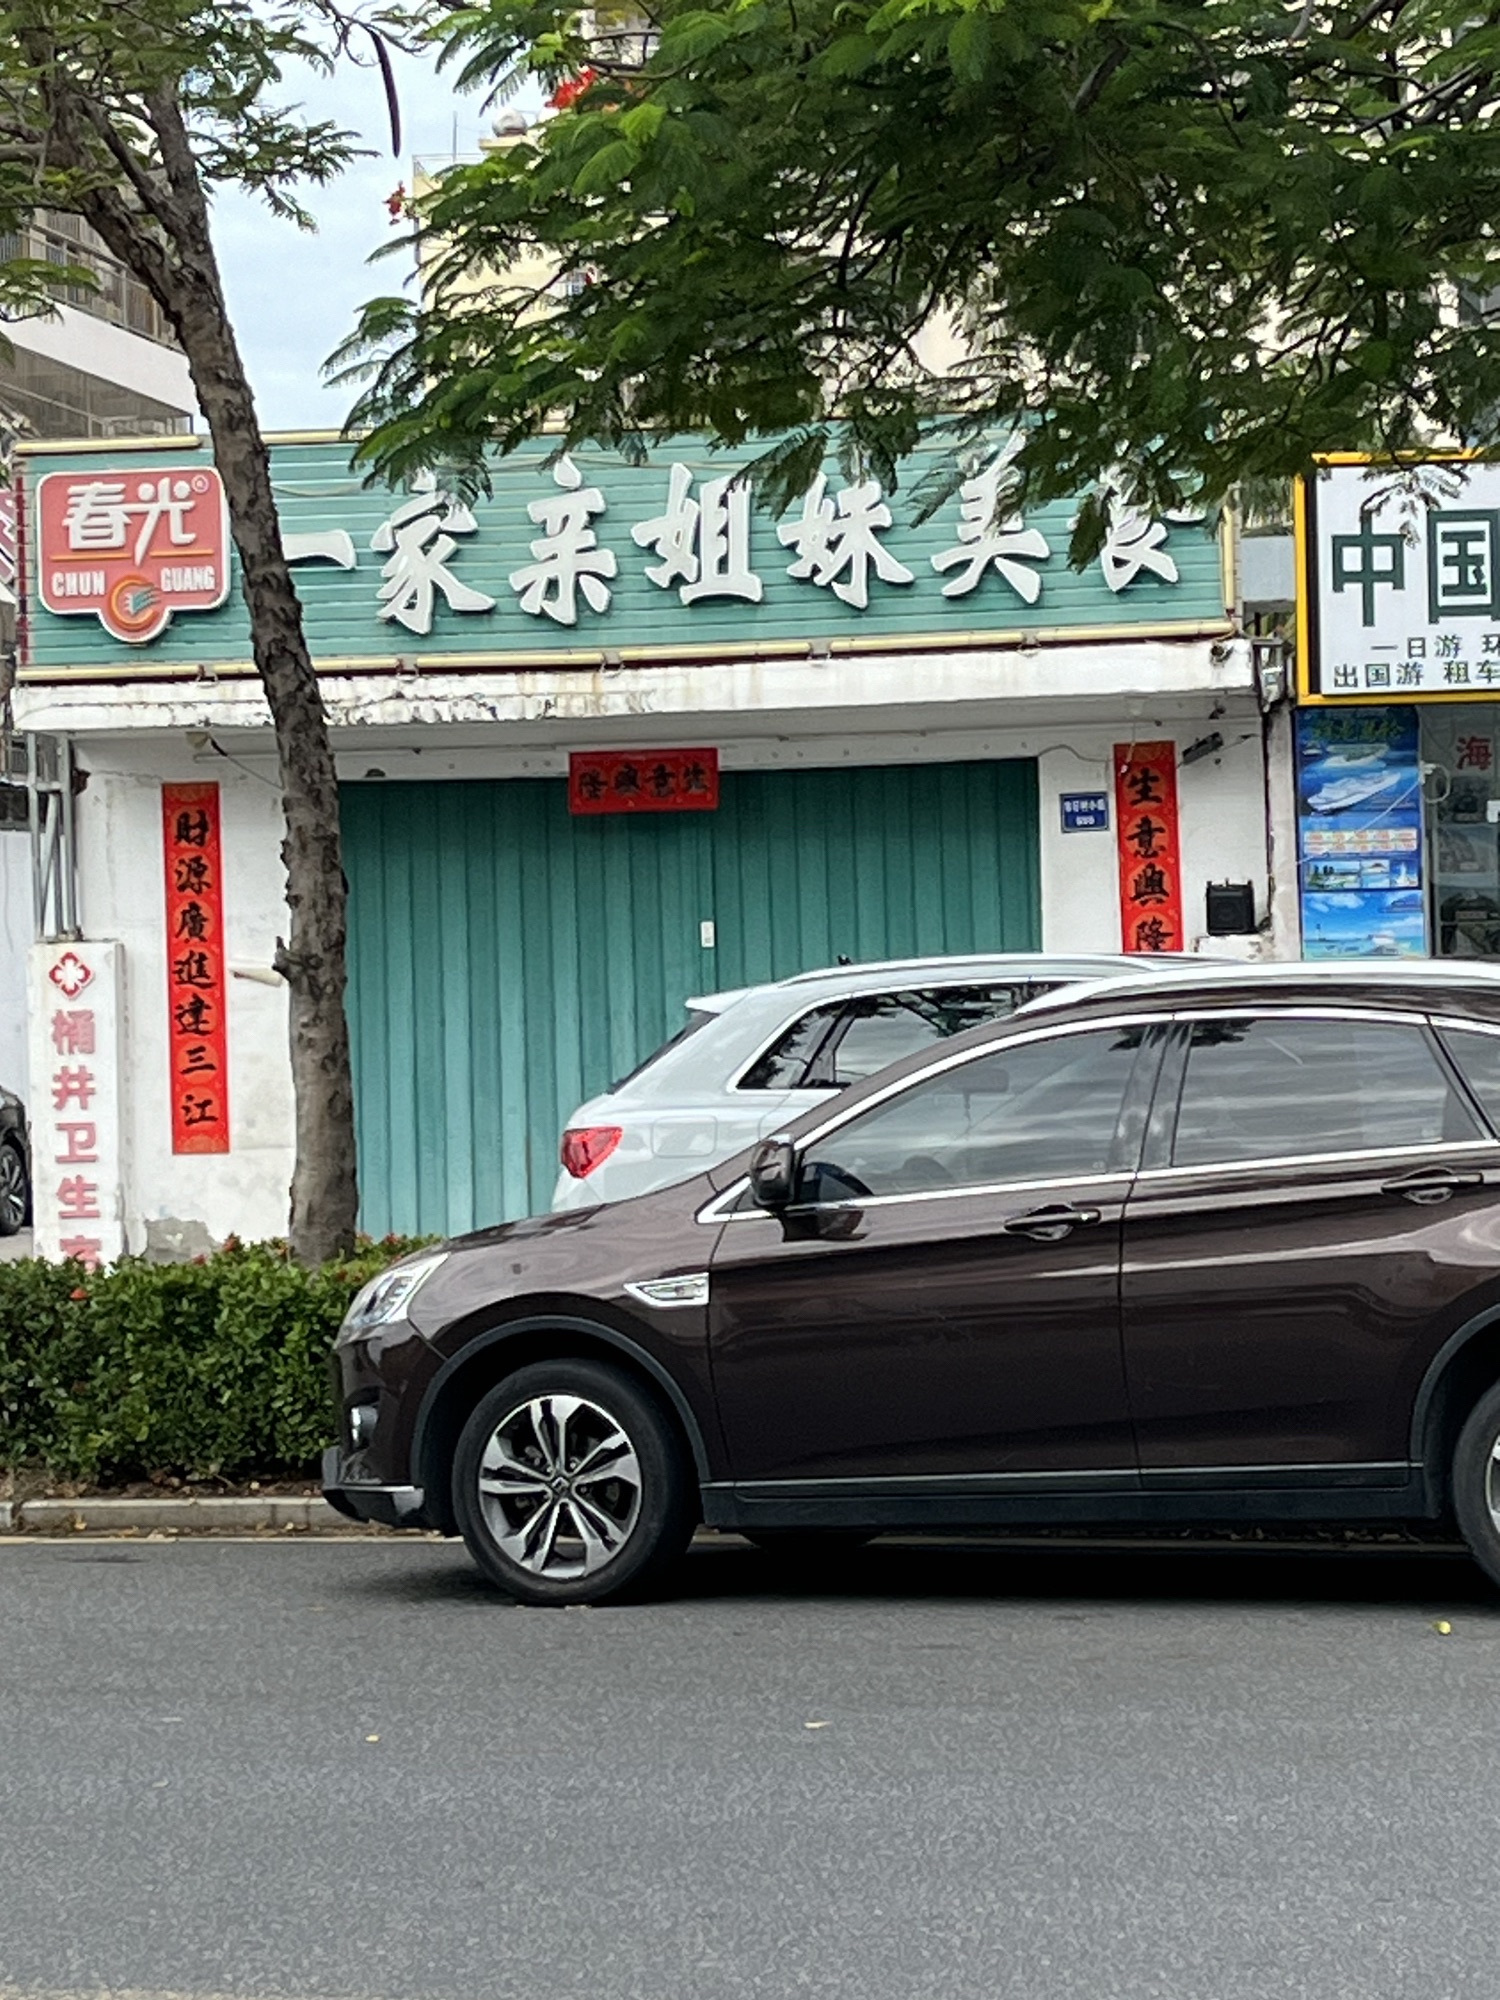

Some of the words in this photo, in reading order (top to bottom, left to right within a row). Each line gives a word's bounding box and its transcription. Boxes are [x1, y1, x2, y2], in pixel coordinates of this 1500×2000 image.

[62, 477, 197, 567] 春光
[51, 570, 106, 598] CHUN
[160, 565, 216, 593] GUANG
[1331, 508, 1500, 628] 中国
[1370, 634, 1463, 660] 一日游
[1333, 661, 1424, 688] 出国游
